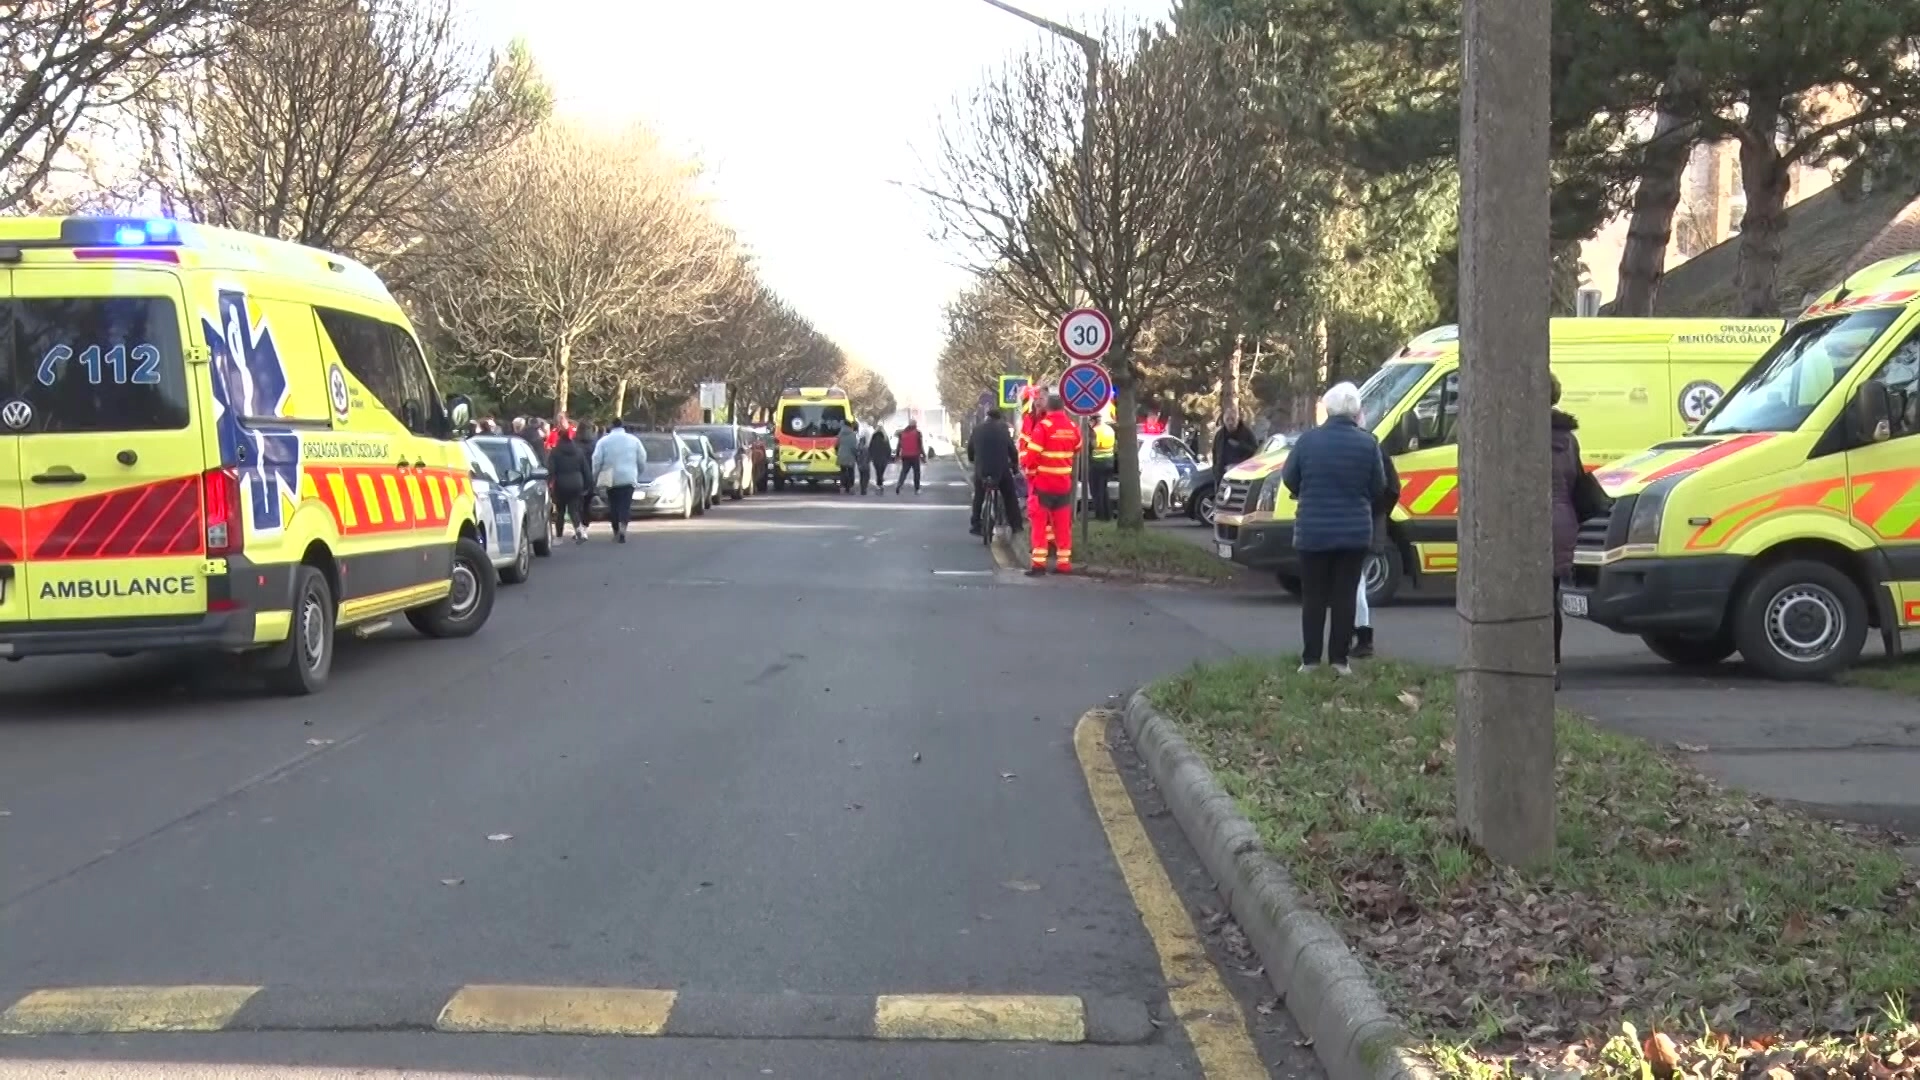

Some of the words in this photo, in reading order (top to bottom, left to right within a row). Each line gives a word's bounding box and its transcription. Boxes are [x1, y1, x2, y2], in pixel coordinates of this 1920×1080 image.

[1073, 325, 1098, 346] 30
[79, 343, 161, 384] 112
[40, 575, 196, 600] AMBULANCE
